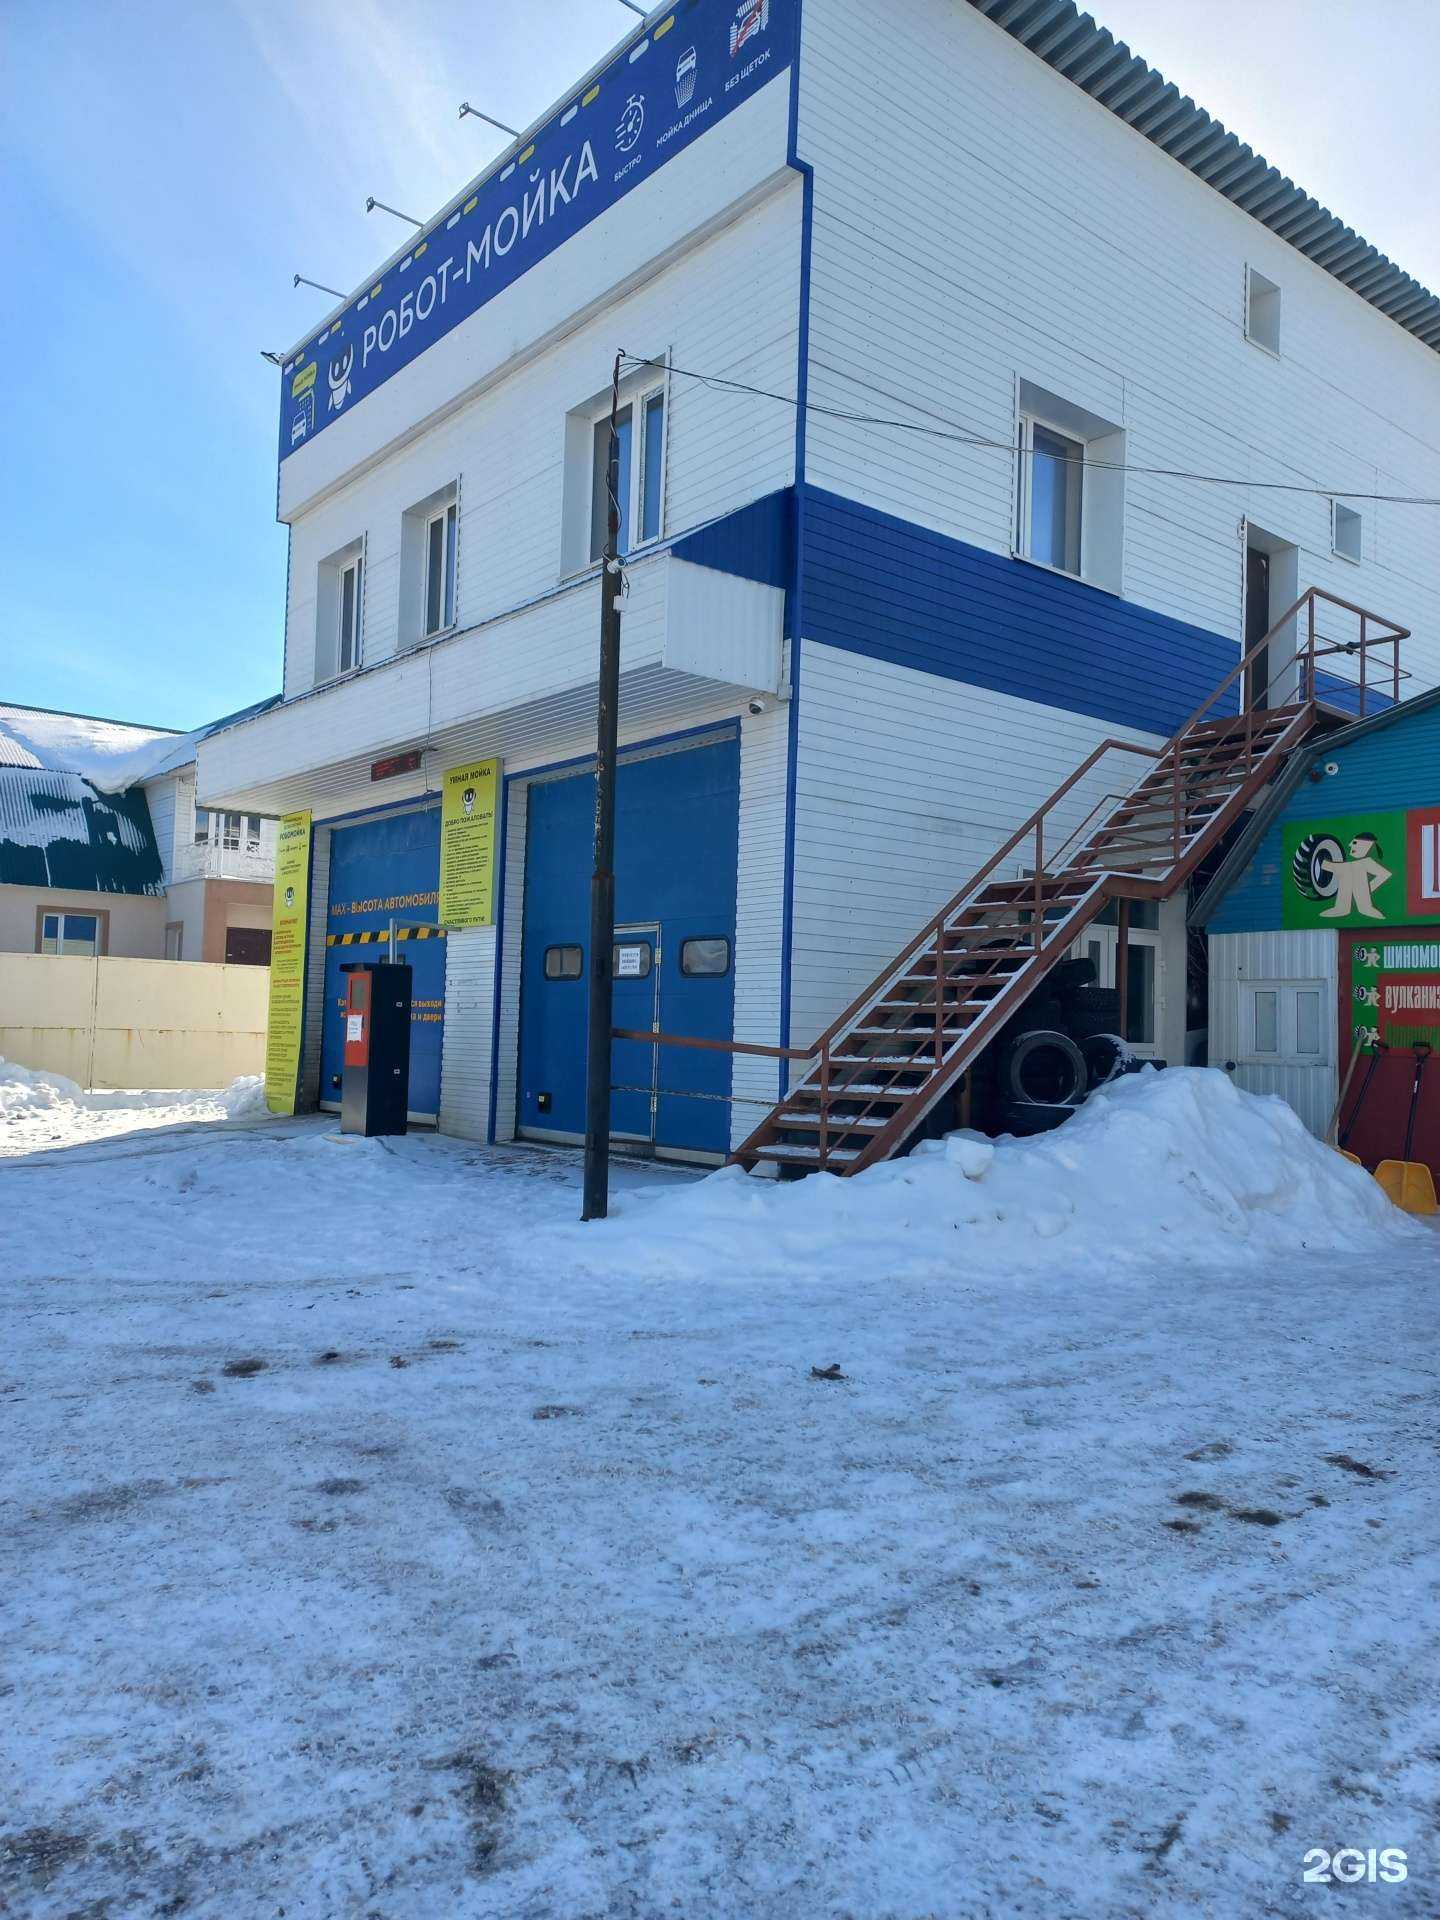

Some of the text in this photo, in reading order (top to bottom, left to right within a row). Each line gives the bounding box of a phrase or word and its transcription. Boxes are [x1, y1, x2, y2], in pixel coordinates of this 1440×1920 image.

[724, 48, 771, 92] БЕЗ ЩЕТОК
[656, 96, 713, 148] МОЙКА ДНИЩА
[613, 153, 643, 183] БЫСТРО
[361, 139, 600, 368] РОБОТ-МОЙКА
[449, 767, 491, 785] УМНАЯ МОЙКА
[351, 898, 384, 915] ВЫСОТА
